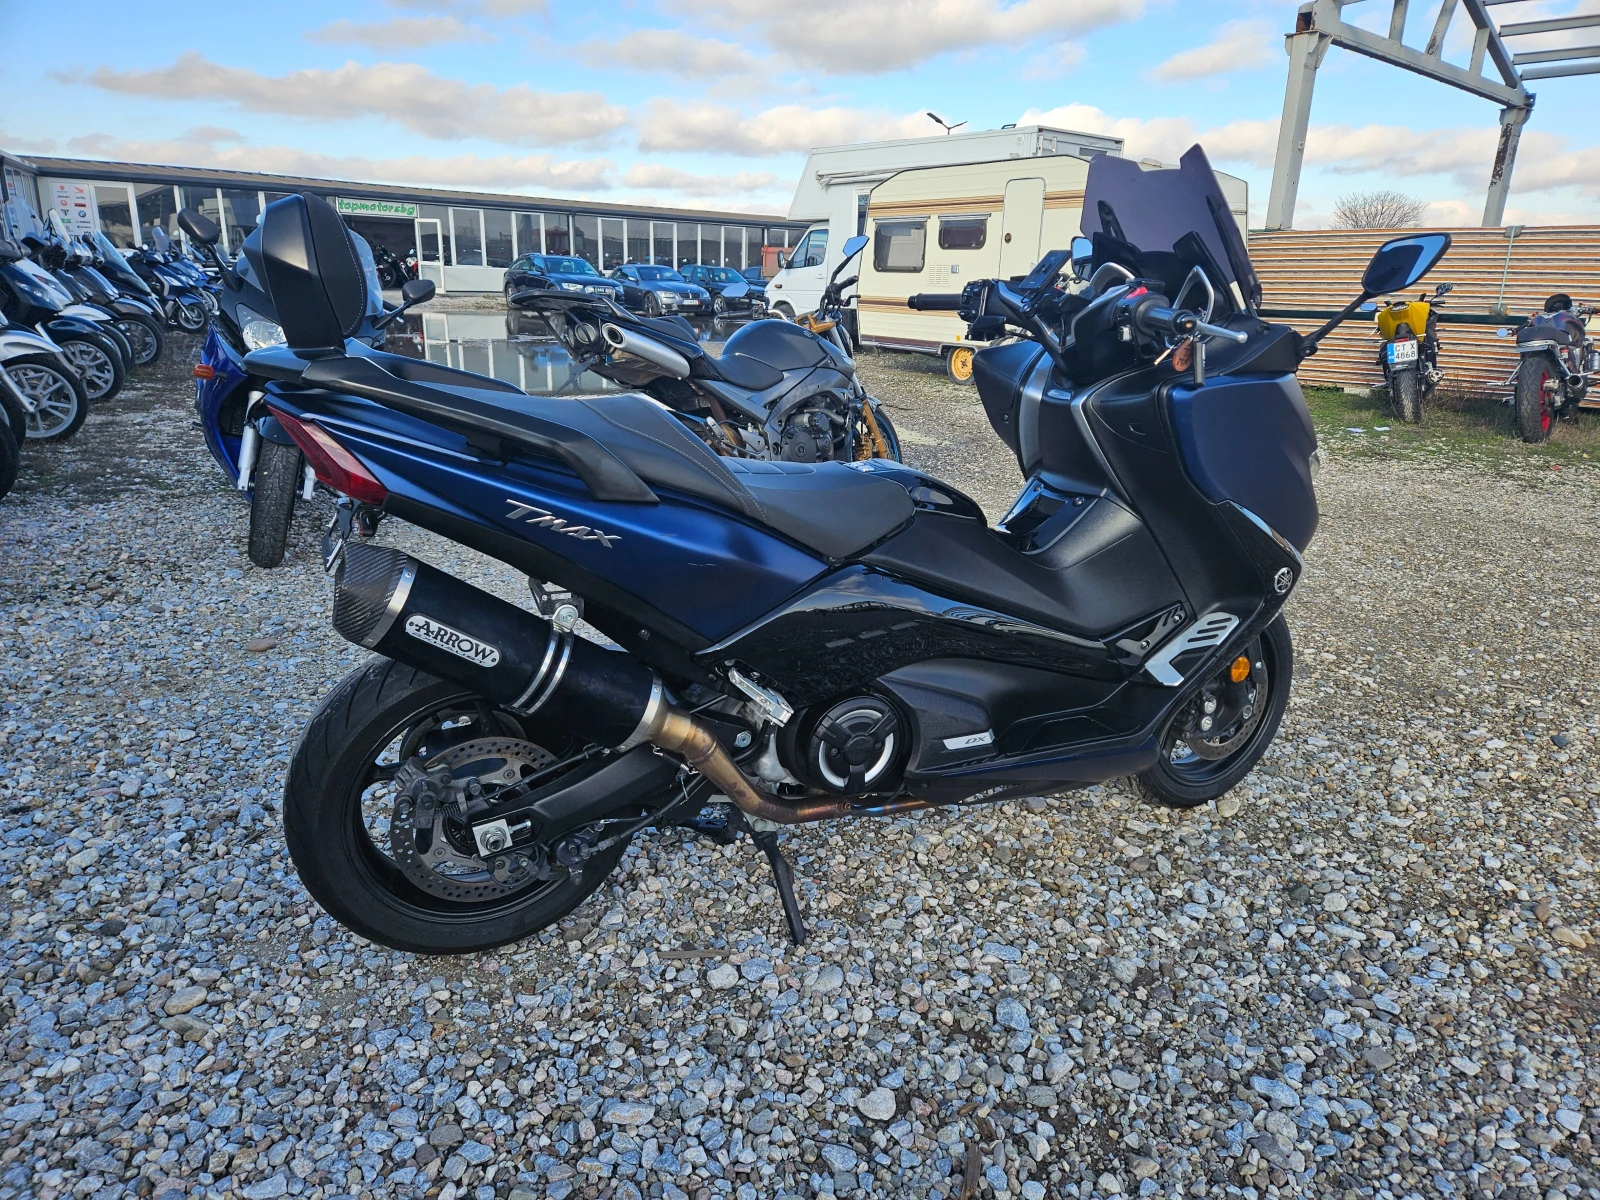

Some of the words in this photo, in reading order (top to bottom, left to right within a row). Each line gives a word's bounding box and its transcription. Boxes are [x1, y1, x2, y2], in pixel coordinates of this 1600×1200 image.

[1410, 342, 1415, 350] X
[1395, 350, 1416, 360] 4868
[505, 499, 622, 548] TMAX
[415, 620, 495, 661] ARROW
[964, 735, 987, 745] DX
